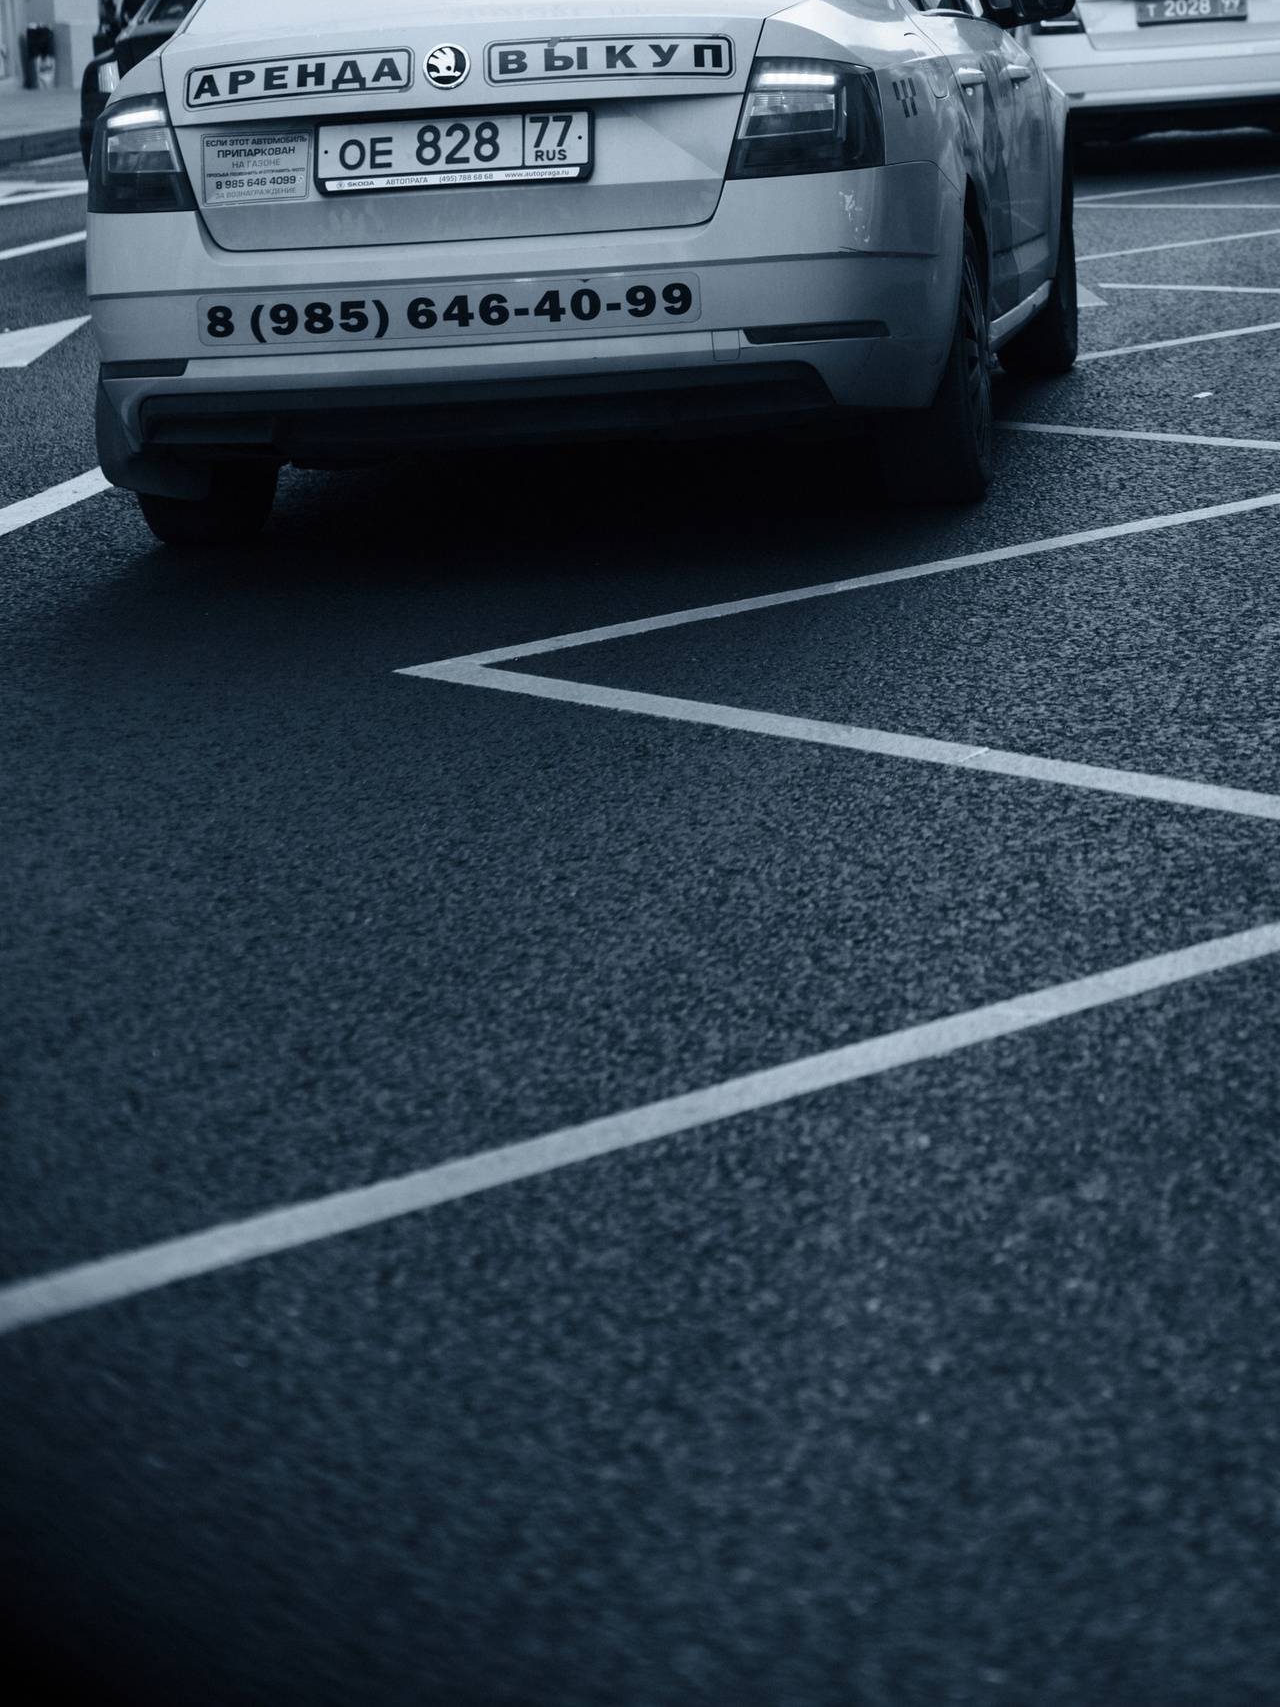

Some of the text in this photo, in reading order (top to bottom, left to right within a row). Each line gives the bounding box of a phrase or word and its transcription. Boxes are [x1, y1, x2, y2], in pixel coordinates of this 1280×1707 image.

[499, 43, 723, 75] ВЫКУП
[192, 57, 403, 101] АРЕНДА
[206, 135, 307, 147] ЕСЛИ ЭТОТ АВТОМОБИЛЬ
[415, 121, 500, 166] 828
[529, 115, 573, 149] 77
[217, 146, 295, 158] ПРИПАРКОВАН
[534, 149, 567, 162] RUS
[232, 158, 280, 169] НА ГАЗОНЕ
[215, 175, 296, 190] 8 985 646 4099
[385, 177, 428, 185] АВТОПРАГА
[439, 175, 457, 183] (495)
[473, 173, 483, 181] 68
[484, 172, 494, 180] 68
[504, 170, 569, 178] www.autopraga.ru
[215, 187, 297, 200] ЗА ВОЗНАГРАЖДЕНИЕ
[206, 282, 693, 344] 8 (985) 646-40-99
